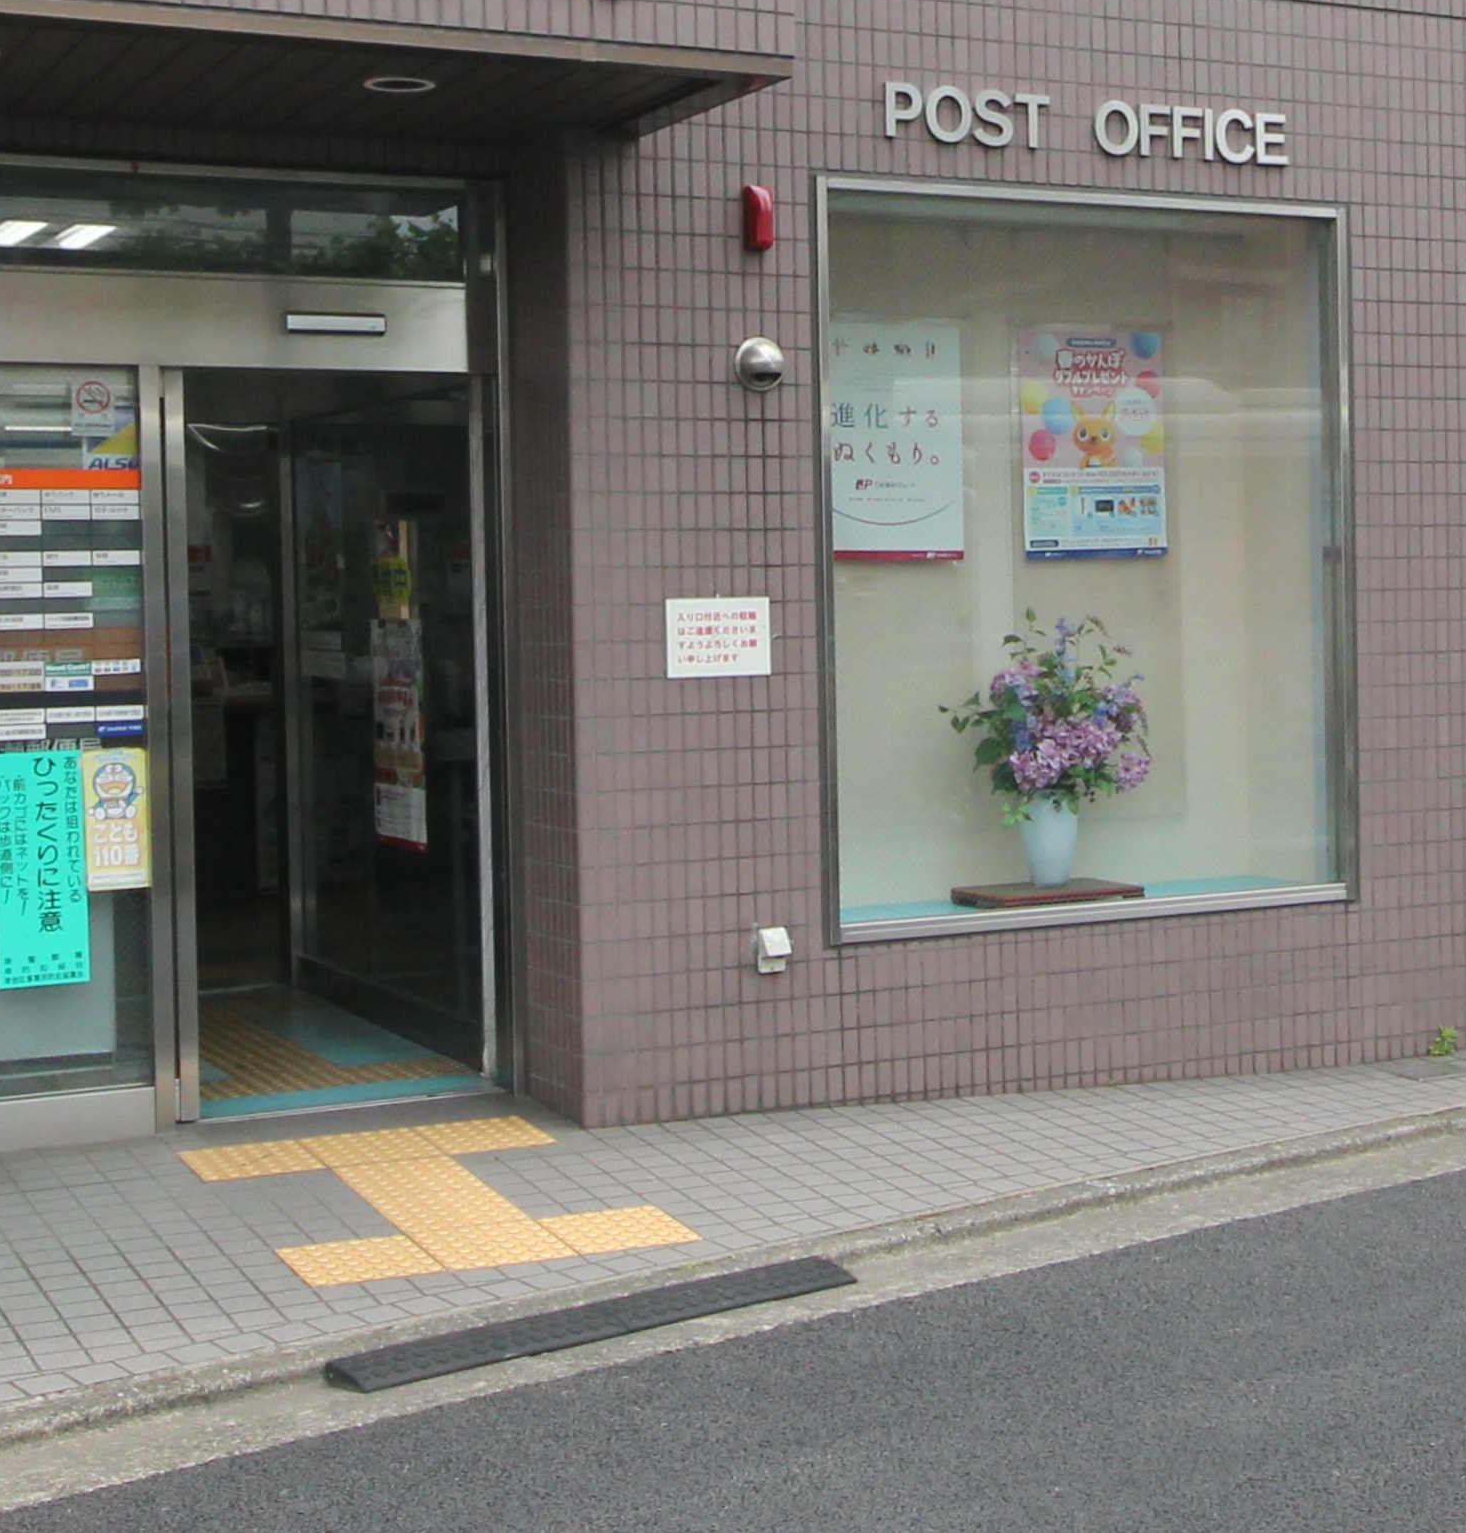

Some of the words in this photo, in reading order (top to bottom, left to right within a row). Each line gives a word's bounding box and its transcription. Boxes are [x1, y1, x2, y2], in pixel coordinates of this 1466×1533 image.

[884, 81, 1051, 149] POST
[1094, 99, 1290, 166] OFFICE
[831, 403, 939, 429] 進化する
[834, 441, 940, 465] ぬくもり。
[677, 653, 739, 664] い申し上げます
[63, 755, 82, 903] あなたは狙われている
[93, 821, 138, 844] こども
[33, 756, 63, 933] ひったくりに注意
[93, 845, 140, 866] 110番
